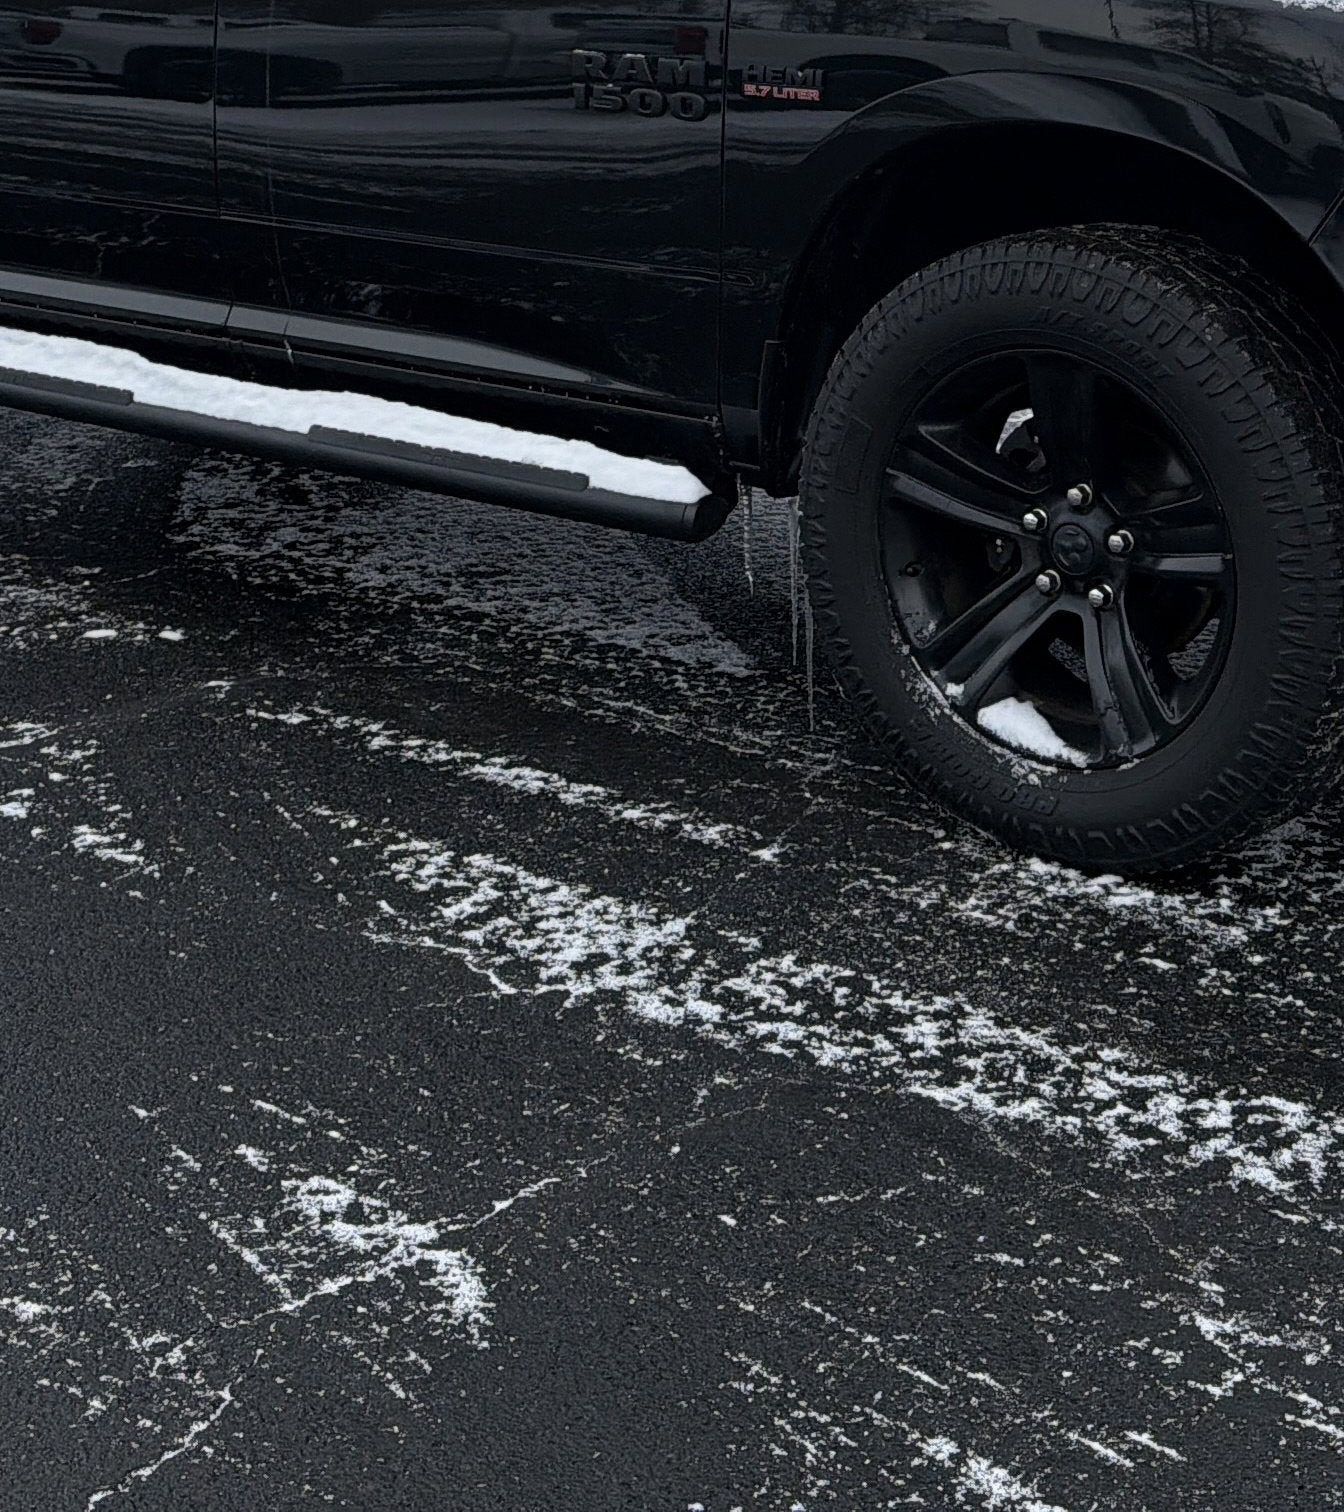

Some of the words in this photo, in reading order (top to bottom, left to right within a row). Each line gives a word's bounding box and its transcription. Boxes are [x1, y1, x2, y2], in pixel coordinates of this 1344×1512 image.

[572, 48, 706, 88] RAM
[742, 64, 824, 87] HEMI
[572, 82, 708, 121] 1500
[743, 84, 771, 99] 5.7
[773, 86, 821, 102] LITER
